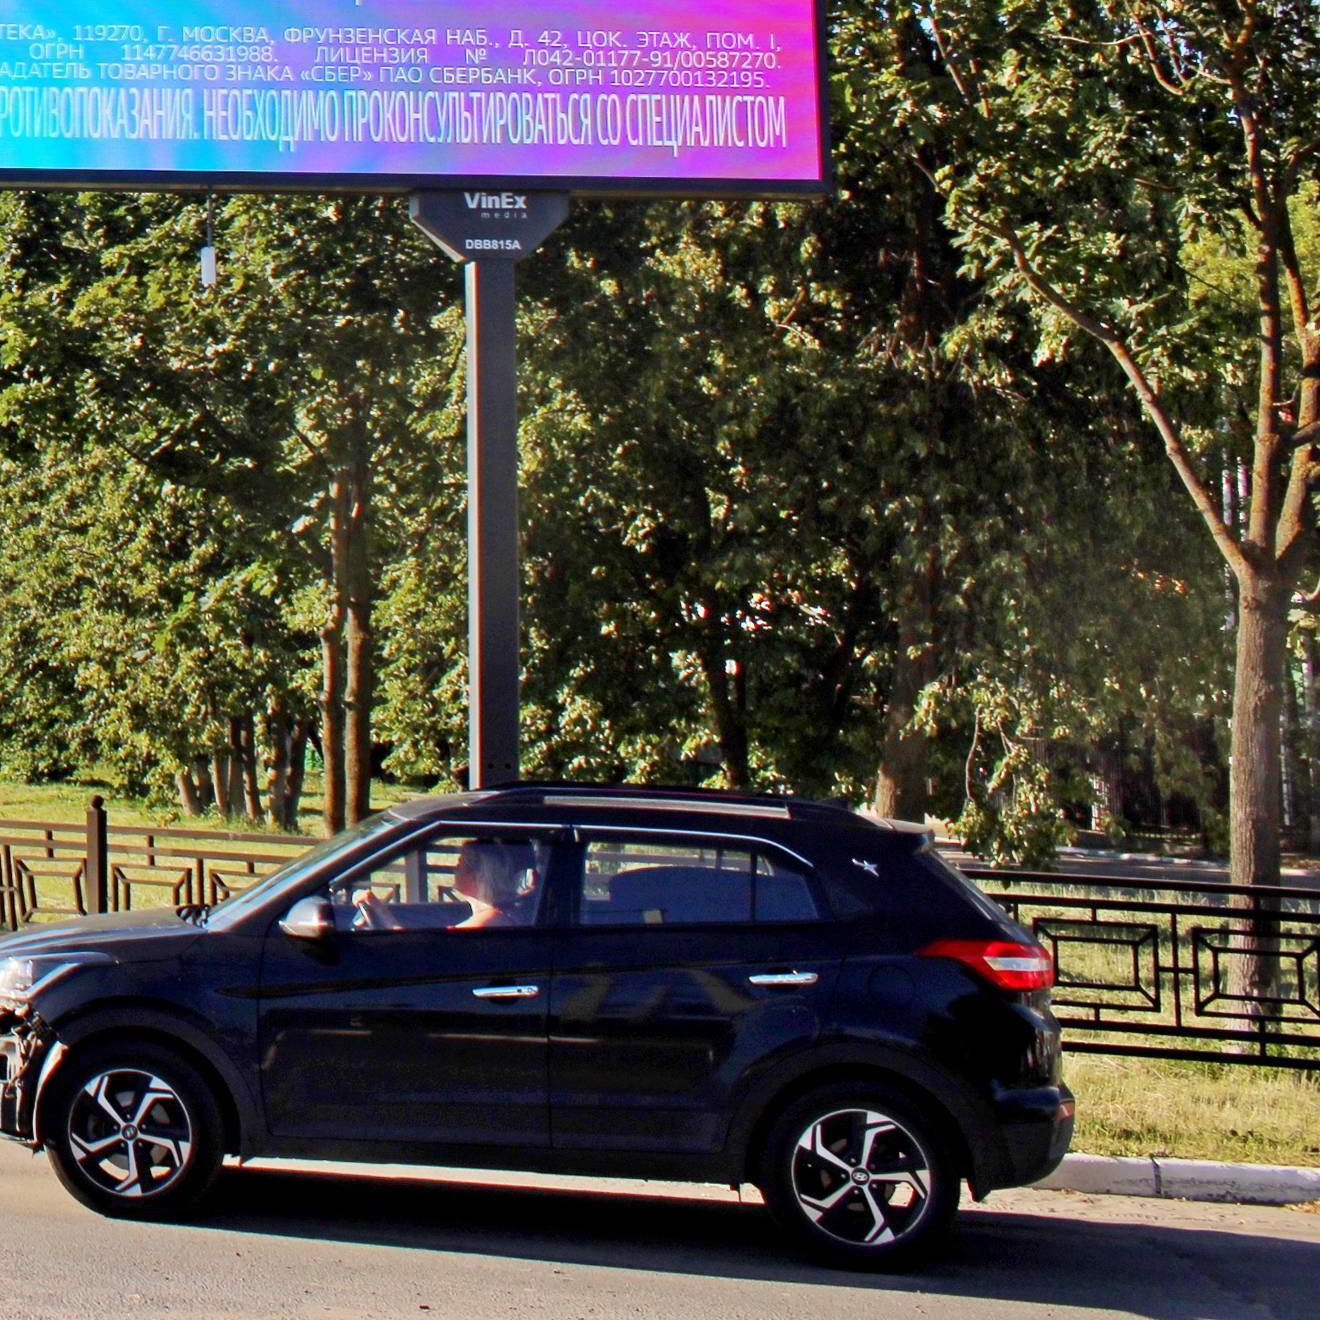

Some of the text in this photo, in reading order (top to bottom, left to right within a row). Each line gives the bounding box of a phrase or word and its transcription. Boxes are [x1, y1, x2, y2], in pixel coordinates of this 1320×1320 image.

[73, 25, 148, 43] 119270,
[182, 26, 275, 45] МОСКВА,
[284, 27, 436, 45] ФРУНЗЕНСКАЯ
[446, 29, 500, 48] НАБ.,
[508, 30, 529, 49] Д.
[537, 30, 568, 49] 42,
[577, 31, 627, 51] ЦОК.
[638, 32, 697, 51] ЭТАЖ,
[706, 32, 760, 50] ПОМ.
[29, 43, 84, 60] ОГРН
[314, 47, 429, 66] ЛИЦЕНЗИЯ
[465, 48, 486, 65] №
[96, 62, 221, 80] ТОВАРНОГО
[226, 65, 294, 81] ЗНАКА
[300, 65, 372, 82] «СБЕР»
[379, 67, 423, 83] ПАО
[430, 67, 542, 86] СБЕРБАНК,
[549, 68, 603, 86] ОГРН
[610, 69, 771, 88] 1027700132195.
[203, 88, 339, 153] НЕОБХОДИМО
[344, 89, 592, 146] ПРОКОНСУЛЬТИРОВАТЬСЯ
[596, 92, 621, 146] СО
[625, 92, 788, 158] СПЕЦИАЛИСТОМ
[464, 192, 527, 209] VinEx
